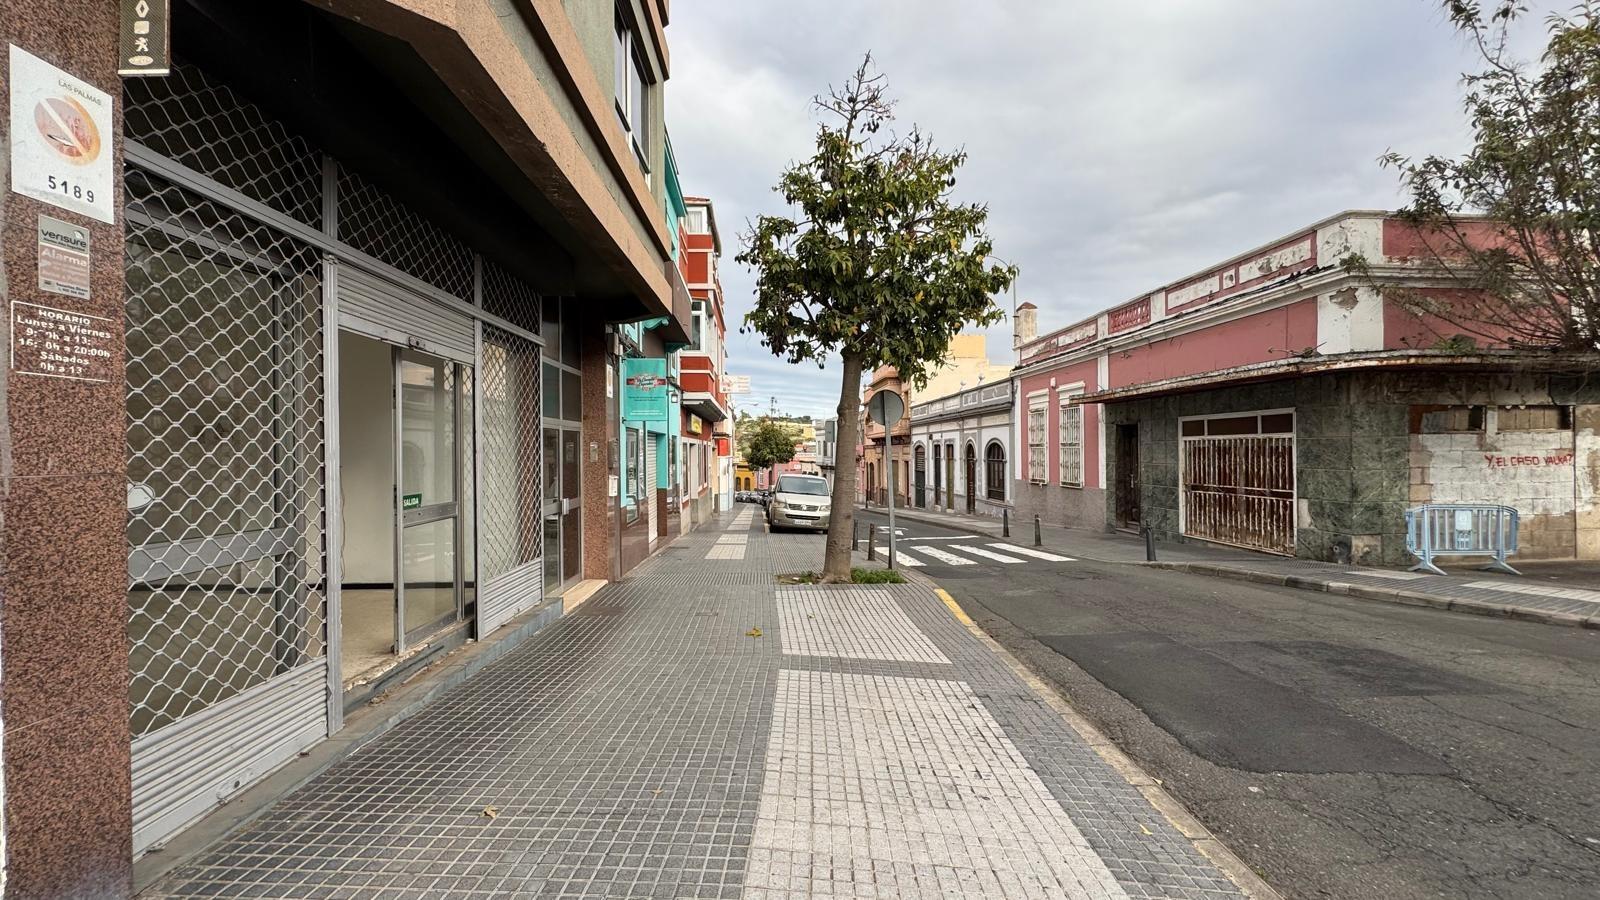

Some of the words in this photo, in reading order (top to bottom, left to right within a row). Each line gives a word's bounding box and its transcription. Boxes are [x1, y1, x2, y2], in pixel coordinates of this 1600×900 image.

[58, 79, 73, 92] LAS
[73, 87, 102, 106] PALMAS
[48, 175, 94, 203] 5189
[41, 228, 87, 248] verisure
[41, 247, 87, 267] Alarma
[38, 309, 91, 325] HORARIO
[17, 314, 55, 329] Lunes
[58, 324, 66, 332] a
[69, 324, 112, 340] Viernes
[63, 334, 71, 342] a
[40, 351, 90, 366] Sábados
[63, 345, 71, 353] a
[74, 345, 111, 359] 20:00h
[1510, 455, 1540, 467] CASO
